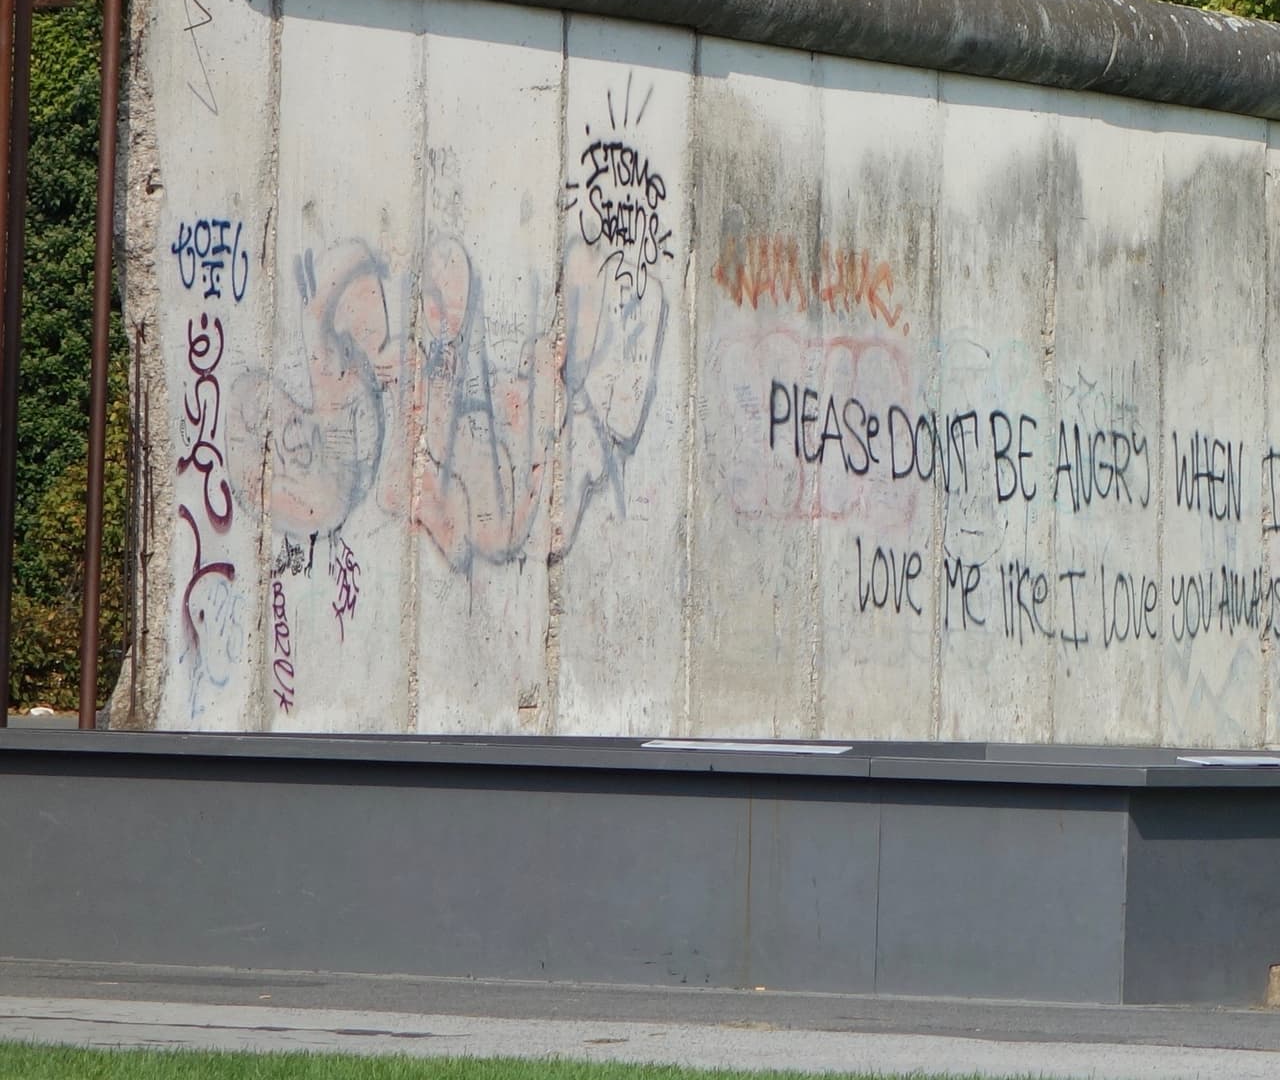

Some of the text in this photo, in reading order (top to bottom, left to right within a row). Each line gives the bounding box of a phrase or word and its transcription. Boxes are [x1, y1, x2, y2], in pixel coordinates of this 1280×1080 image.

[989, 410, 1037, 504] BE
[1053, 420, 1150, 514] ANGRY
[1173, 429, 1244, 521] WHEN
[944, 556, 986, 631] Me
[1058, 570, 1088, 651] I
